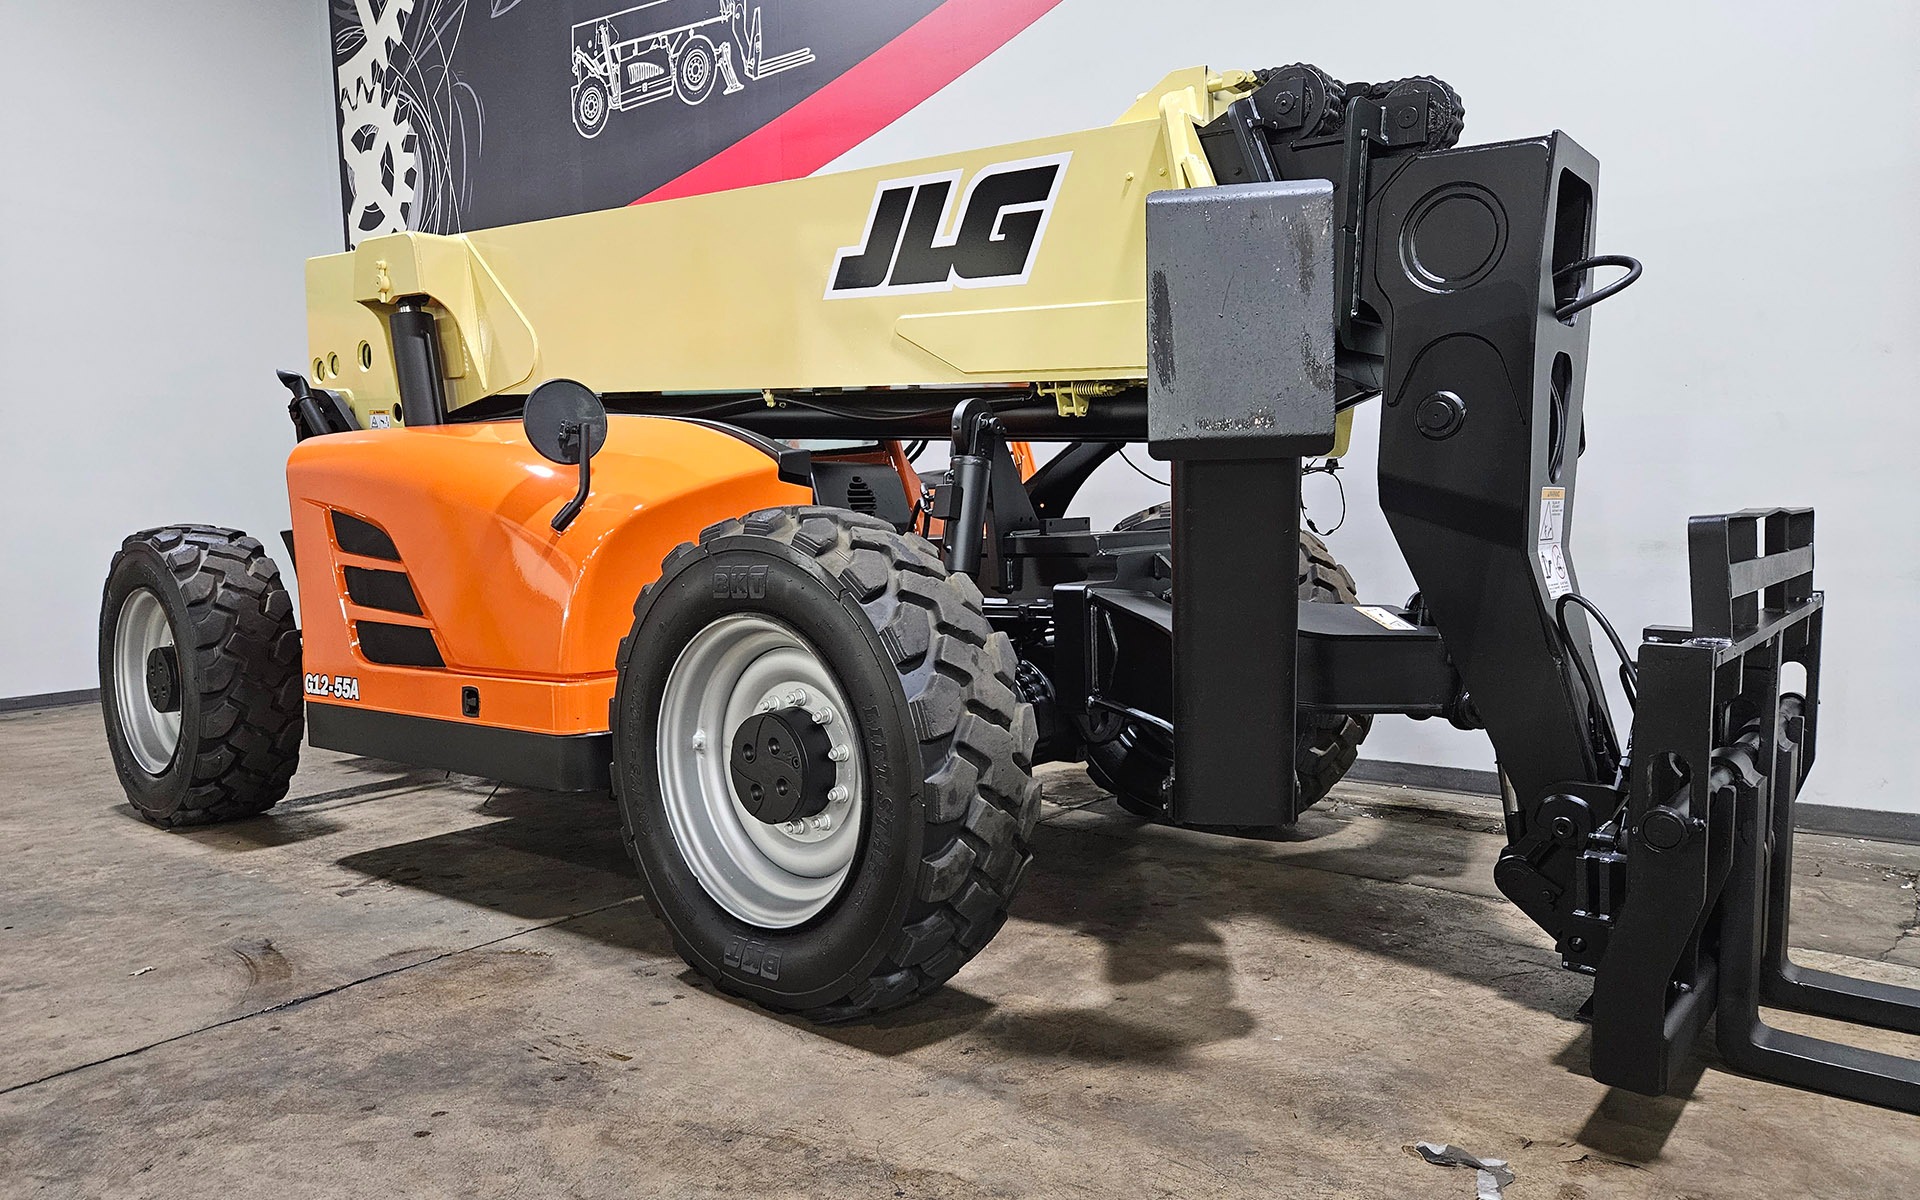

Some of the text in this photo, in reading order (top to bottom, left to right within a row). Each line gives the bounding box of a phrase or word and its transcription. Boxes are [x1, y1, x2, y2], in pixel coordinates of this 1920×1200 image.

[829, 160, 1063, 292] JLG
[712, 563, 769, 600] BKT
[304, 672, 360, 701] G12-55A
[723, 934, 784, 981] BKT
